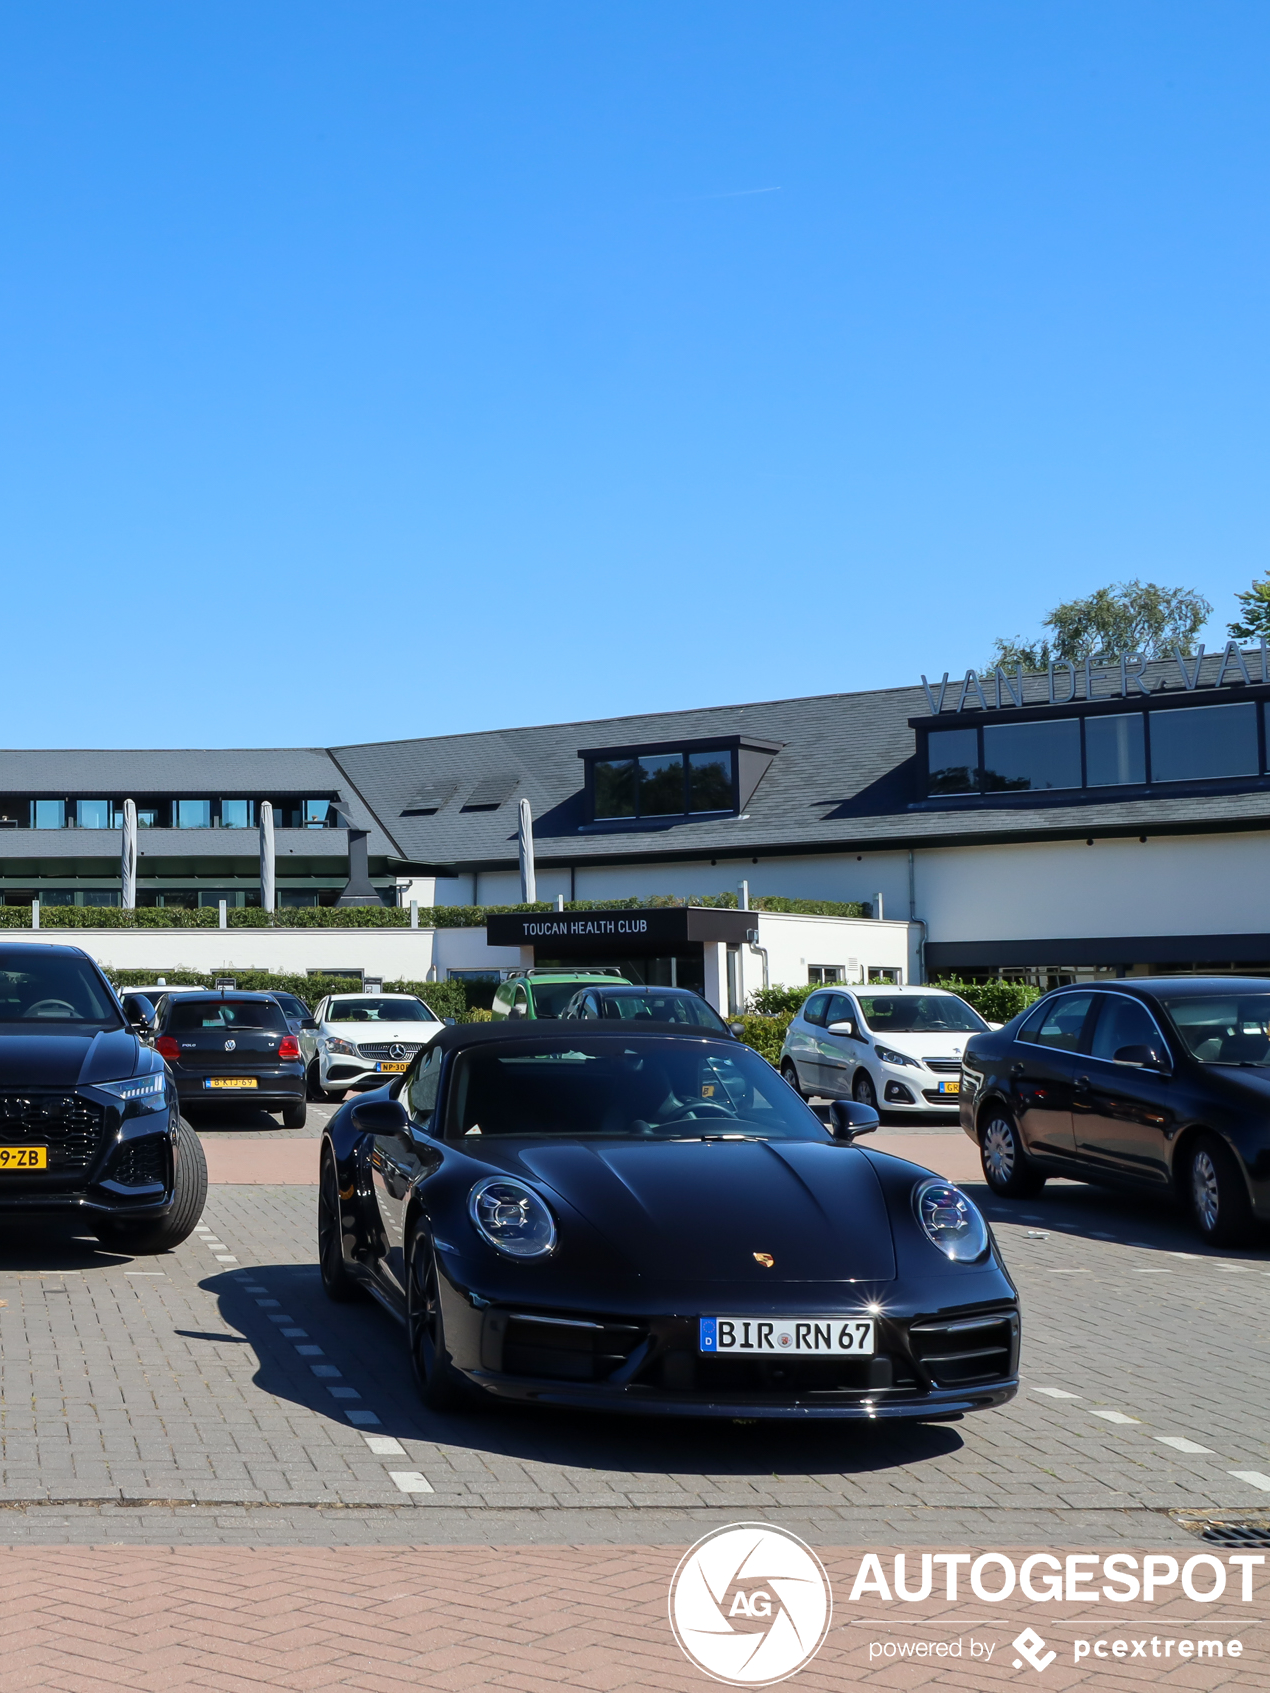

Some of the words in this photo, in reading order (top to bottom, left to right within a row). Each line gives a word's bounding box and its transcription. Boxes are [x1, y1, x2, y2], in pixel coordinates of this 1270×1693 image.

[921, 665, 1022, 715] VAN
[1048, 651, 1151, 704] DER
[523, 922, 567, 935] TOUCAN
[571, 921, 615, 934] HEALTH
[618, 919, 648, 933] CLUB
[214, 1079, 253, 1087] 8-KTJ-69
[705, 1337, 712, 1345] D
[718, 1321, 775, 1349] BIR
[795, 1323, 831, 1350] RN
[838, 1323, 871, 1349] 67
